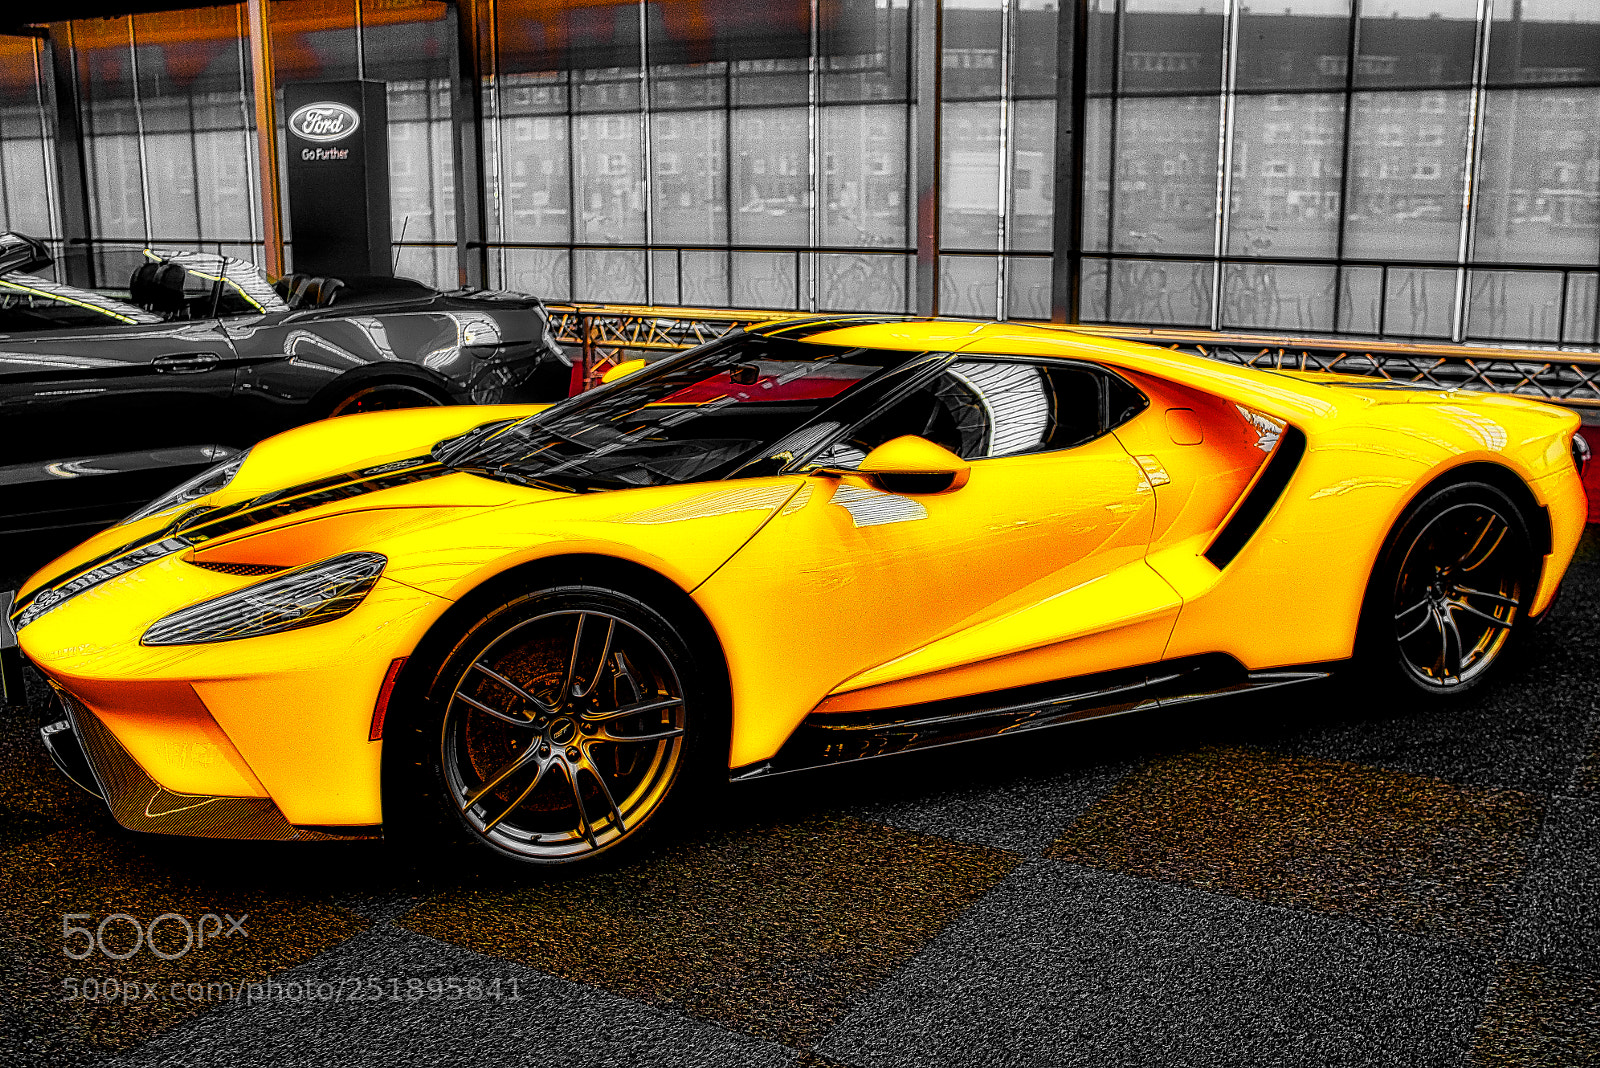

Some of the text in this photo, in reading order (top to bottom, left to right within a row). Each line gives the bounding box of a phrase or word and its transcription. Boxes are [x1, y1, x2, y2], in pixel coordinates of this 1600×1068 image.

[302, 108, 344, 133] Ford
[302, 147, 349, 161] Go Further
